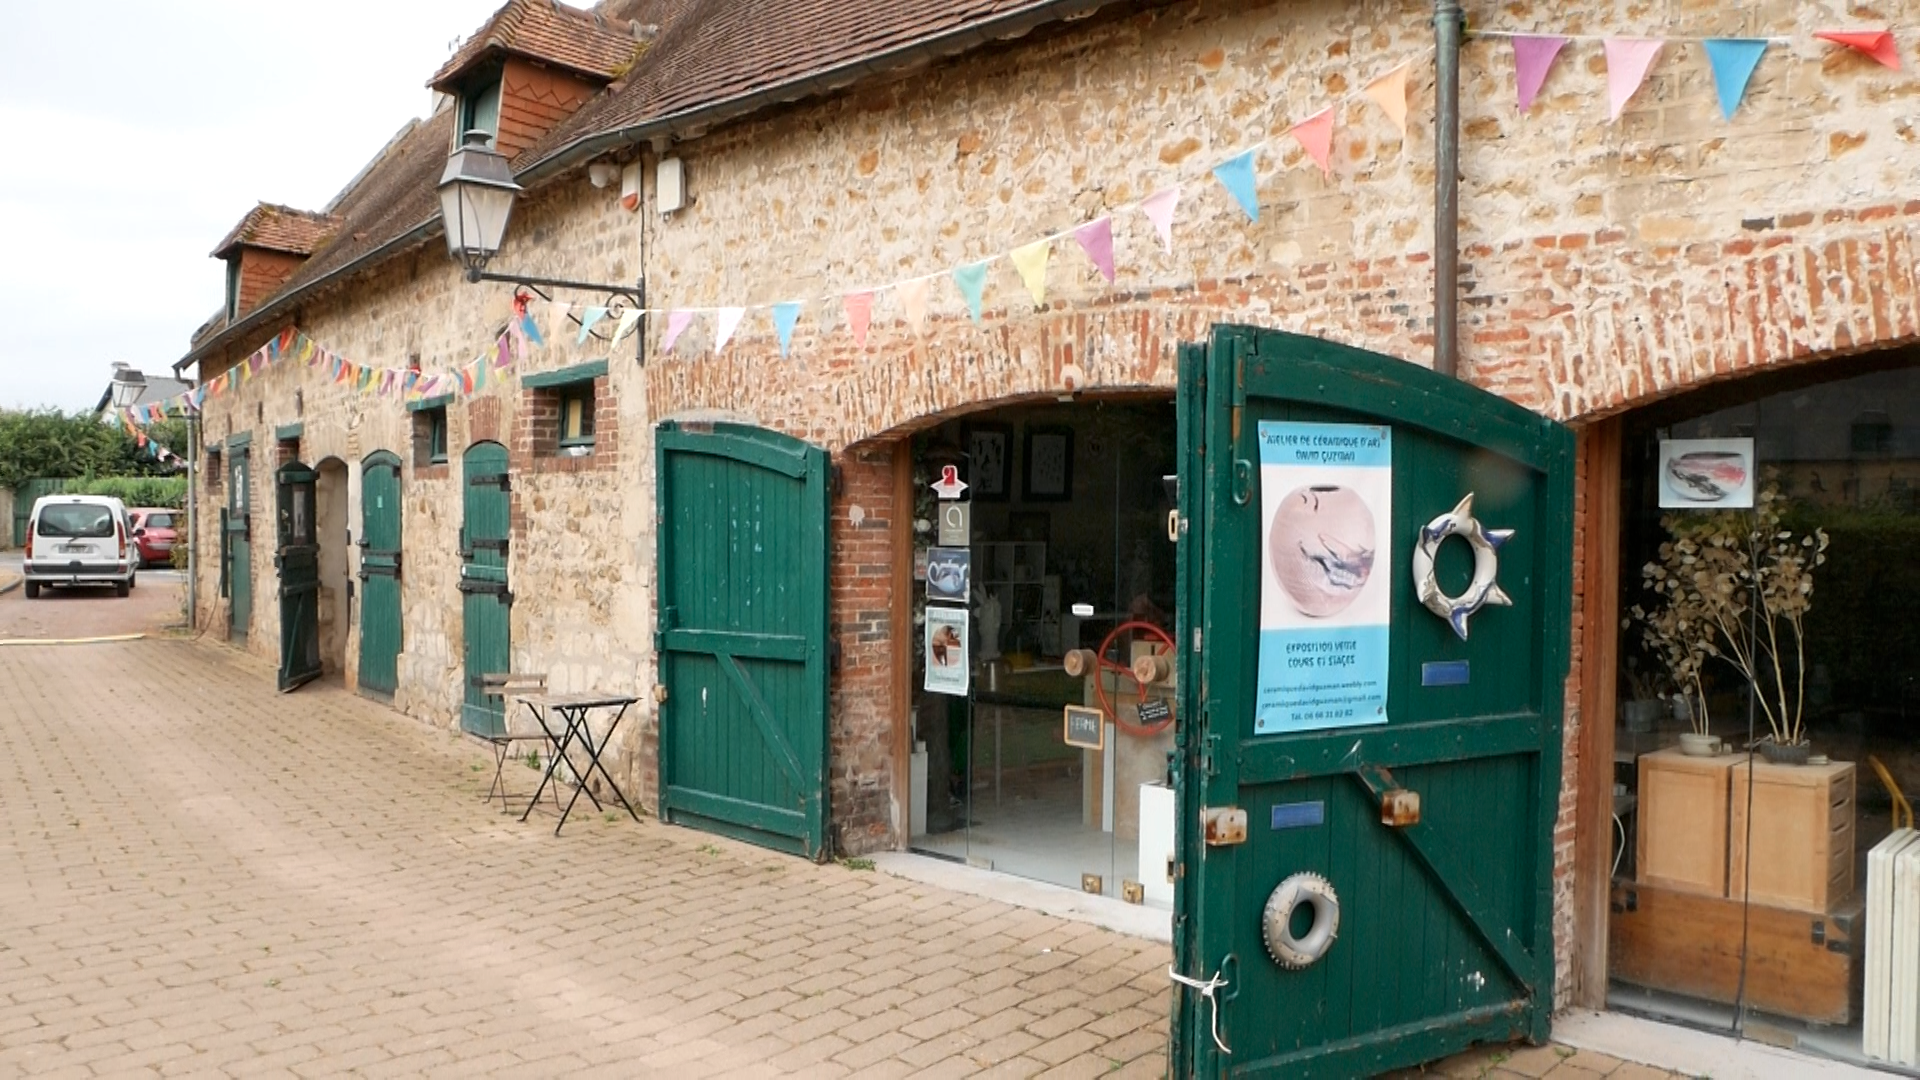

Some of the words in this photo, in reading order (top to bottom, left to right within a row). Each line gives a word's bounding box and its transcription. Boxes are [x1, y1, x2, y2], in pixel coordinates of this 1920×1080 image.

[1267, 435, 1297, 446] ATELIER
[1300, 435, 1310, 446] DE
[1313, 434, 1358, 447] CÉRAMIQUE
[1296, 450, 1319, 460] DAVID
[1286, 641, 1332, 653] EXPOSITION
[1335, 640, 1356, 651] VENTE
[1288, 656, 1314, 668] COURS
[1317, 656, 1326, 667] ET
[1328, 655, 1355, 667] STAGES
